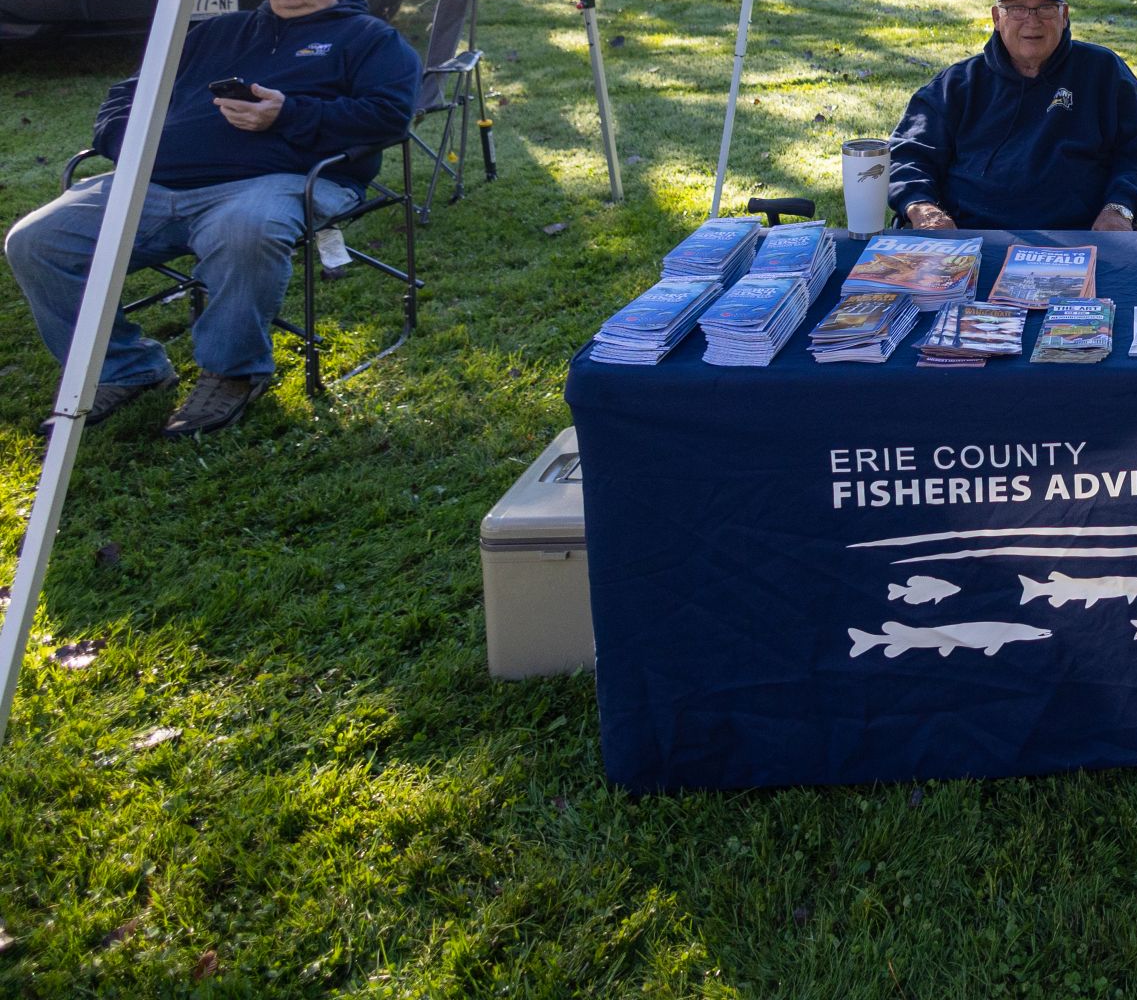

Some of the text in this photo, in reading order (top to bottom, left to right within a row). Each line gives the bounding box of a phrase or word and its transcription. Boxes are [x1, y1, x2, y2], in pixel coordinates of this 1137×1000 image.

[864, 238, 981, 257] Buffalo
[1014, 252, 1086, 265] BUFFALO
[830, 441, 1087, 473] ERIE COUNTY
[832, 475, 1032, 509] FISHERIES
